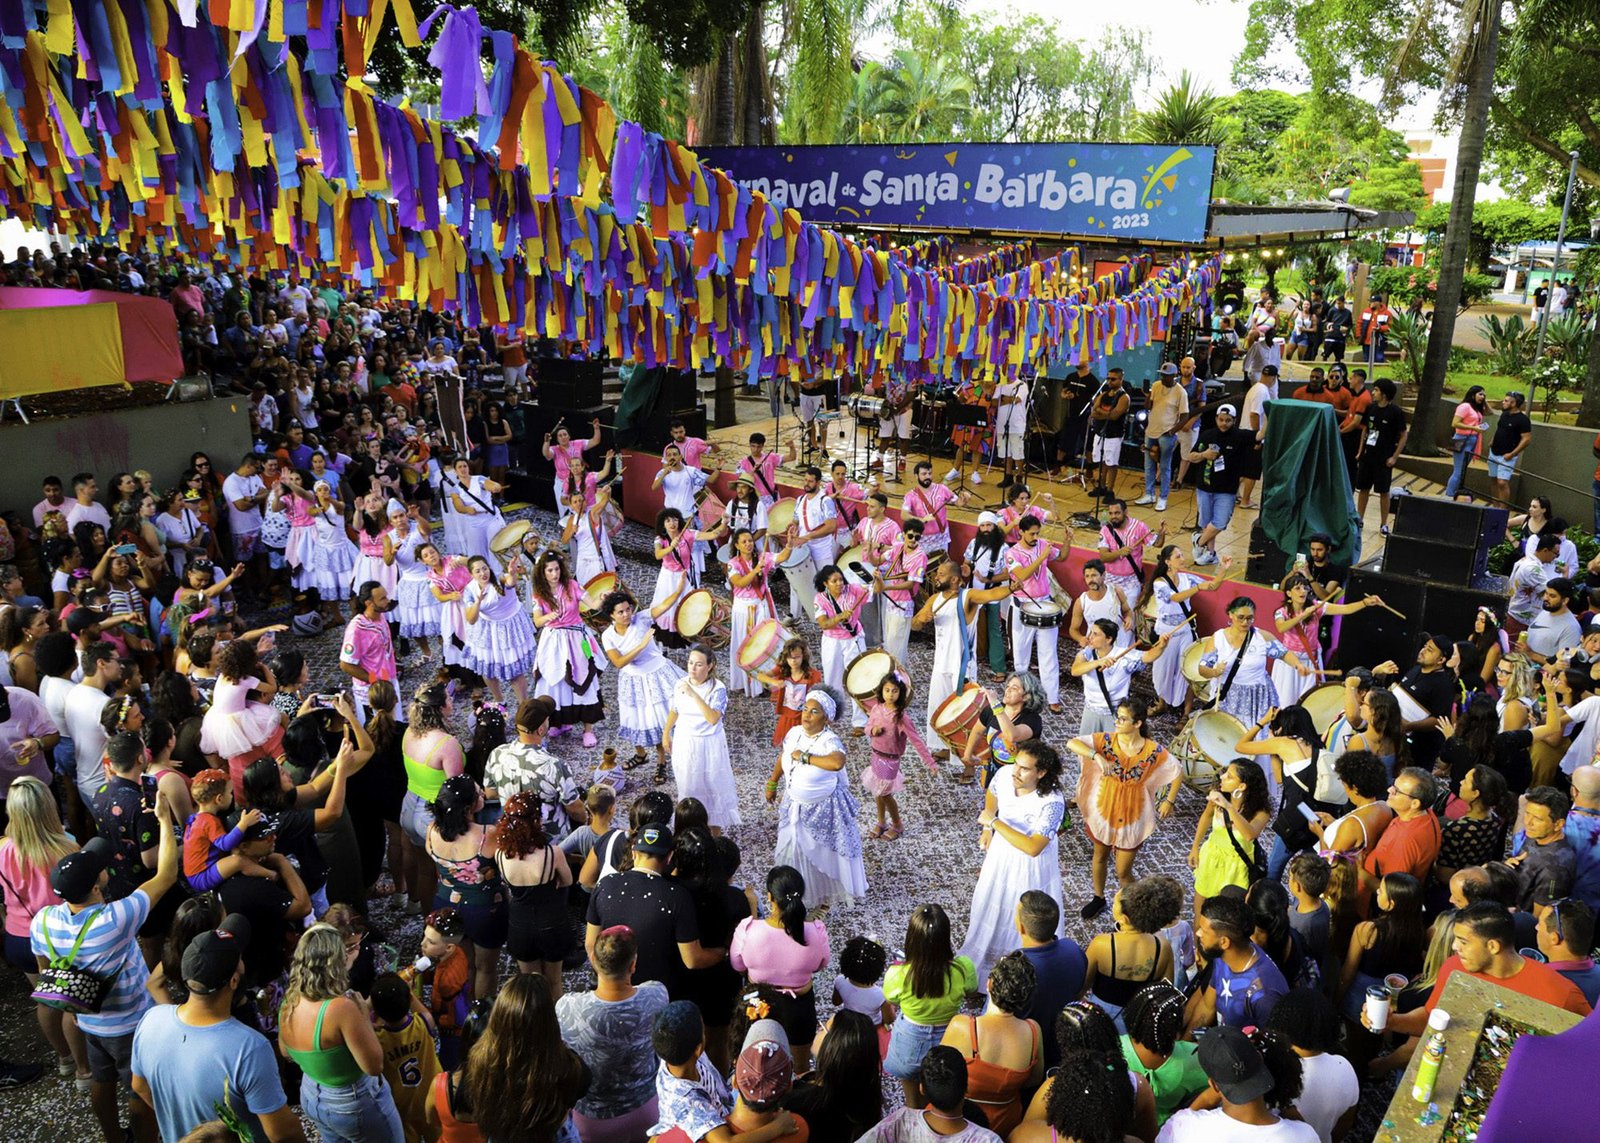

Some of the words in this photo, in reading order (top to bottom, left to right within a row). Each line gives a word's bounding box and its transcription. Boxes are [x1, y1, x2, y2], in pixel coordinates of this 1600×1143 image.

[841, 183, 856, 197] de
[859, 169, 959, 207] Santa
[974, 163, 1137, 211] Bárbara
[1112, 212, 1150, 230] 2023
[398, 1056, 423, 1087] 6
